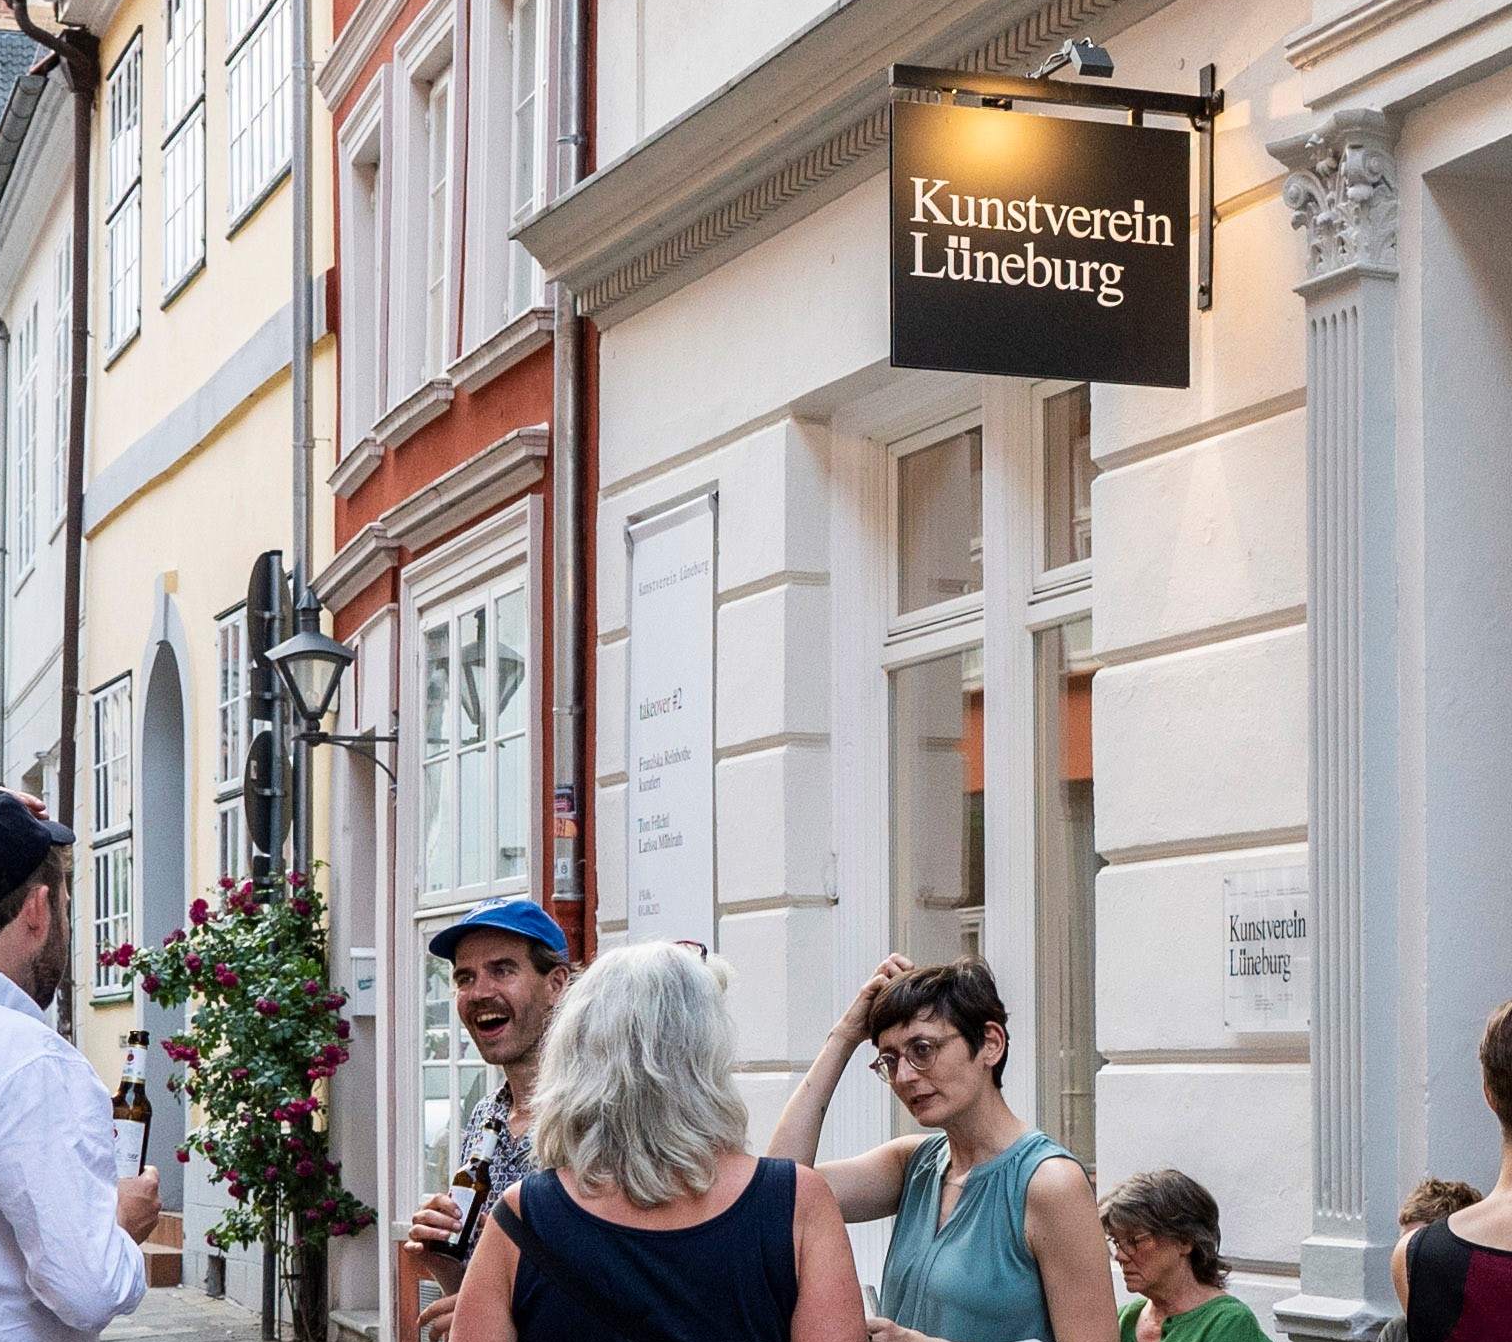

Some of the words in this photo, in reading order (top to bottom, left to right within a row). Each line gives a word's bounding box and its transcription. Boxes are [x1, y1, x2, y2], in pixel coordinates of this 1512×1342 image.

[909, 176, 1175, 247] Kunstverein
[909, 232, 1125, 308] Lüneburg
[639, 697, 671, 720] takeover
[1229, 909, 1306, 942] Kunstverein
[1229, 948, 1291, 982] Lüneburg
